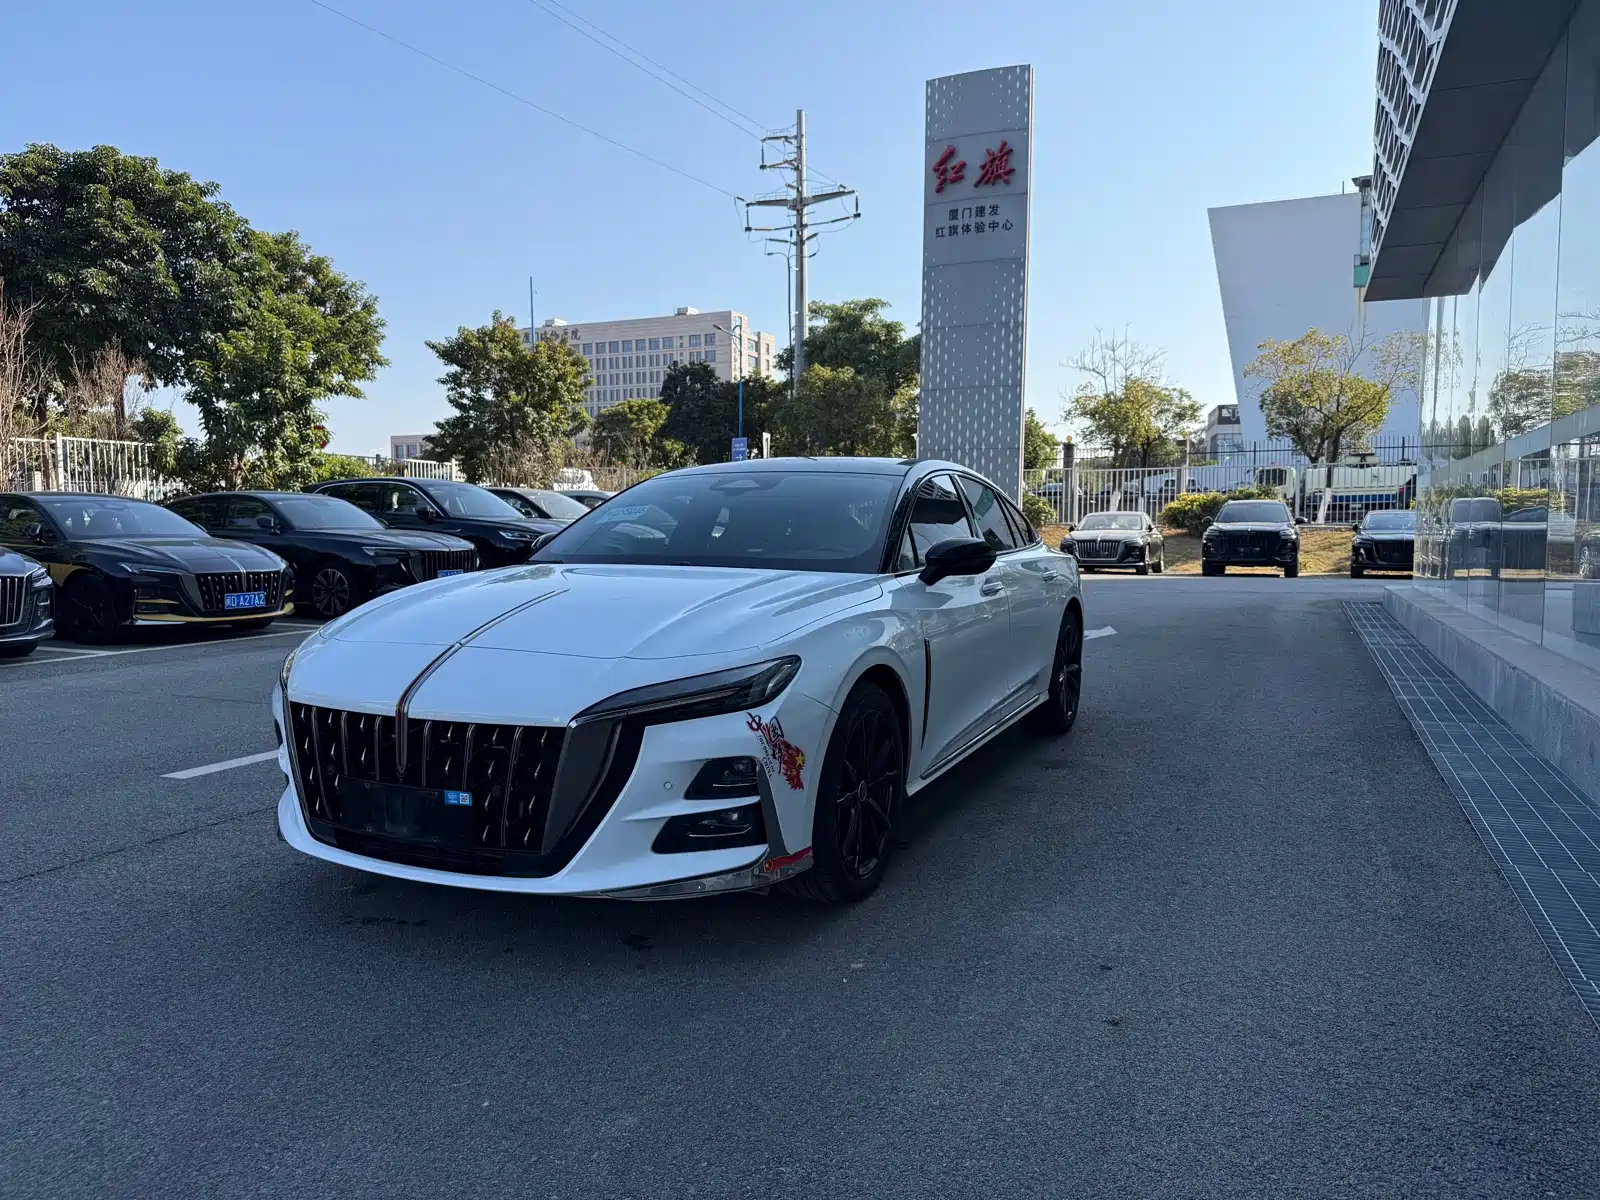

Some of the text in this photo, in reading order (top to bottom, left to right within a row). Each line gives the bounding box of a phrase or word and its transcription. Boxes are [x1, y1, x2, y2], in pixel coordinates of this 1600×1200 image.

[932, 140, 1016, 194] 红旗
[948, 204, 1000, 222] 厦门建发
[935, 219, 1014, 239] 红旗体验中心
[762, 756, 772, 778] CHINA
